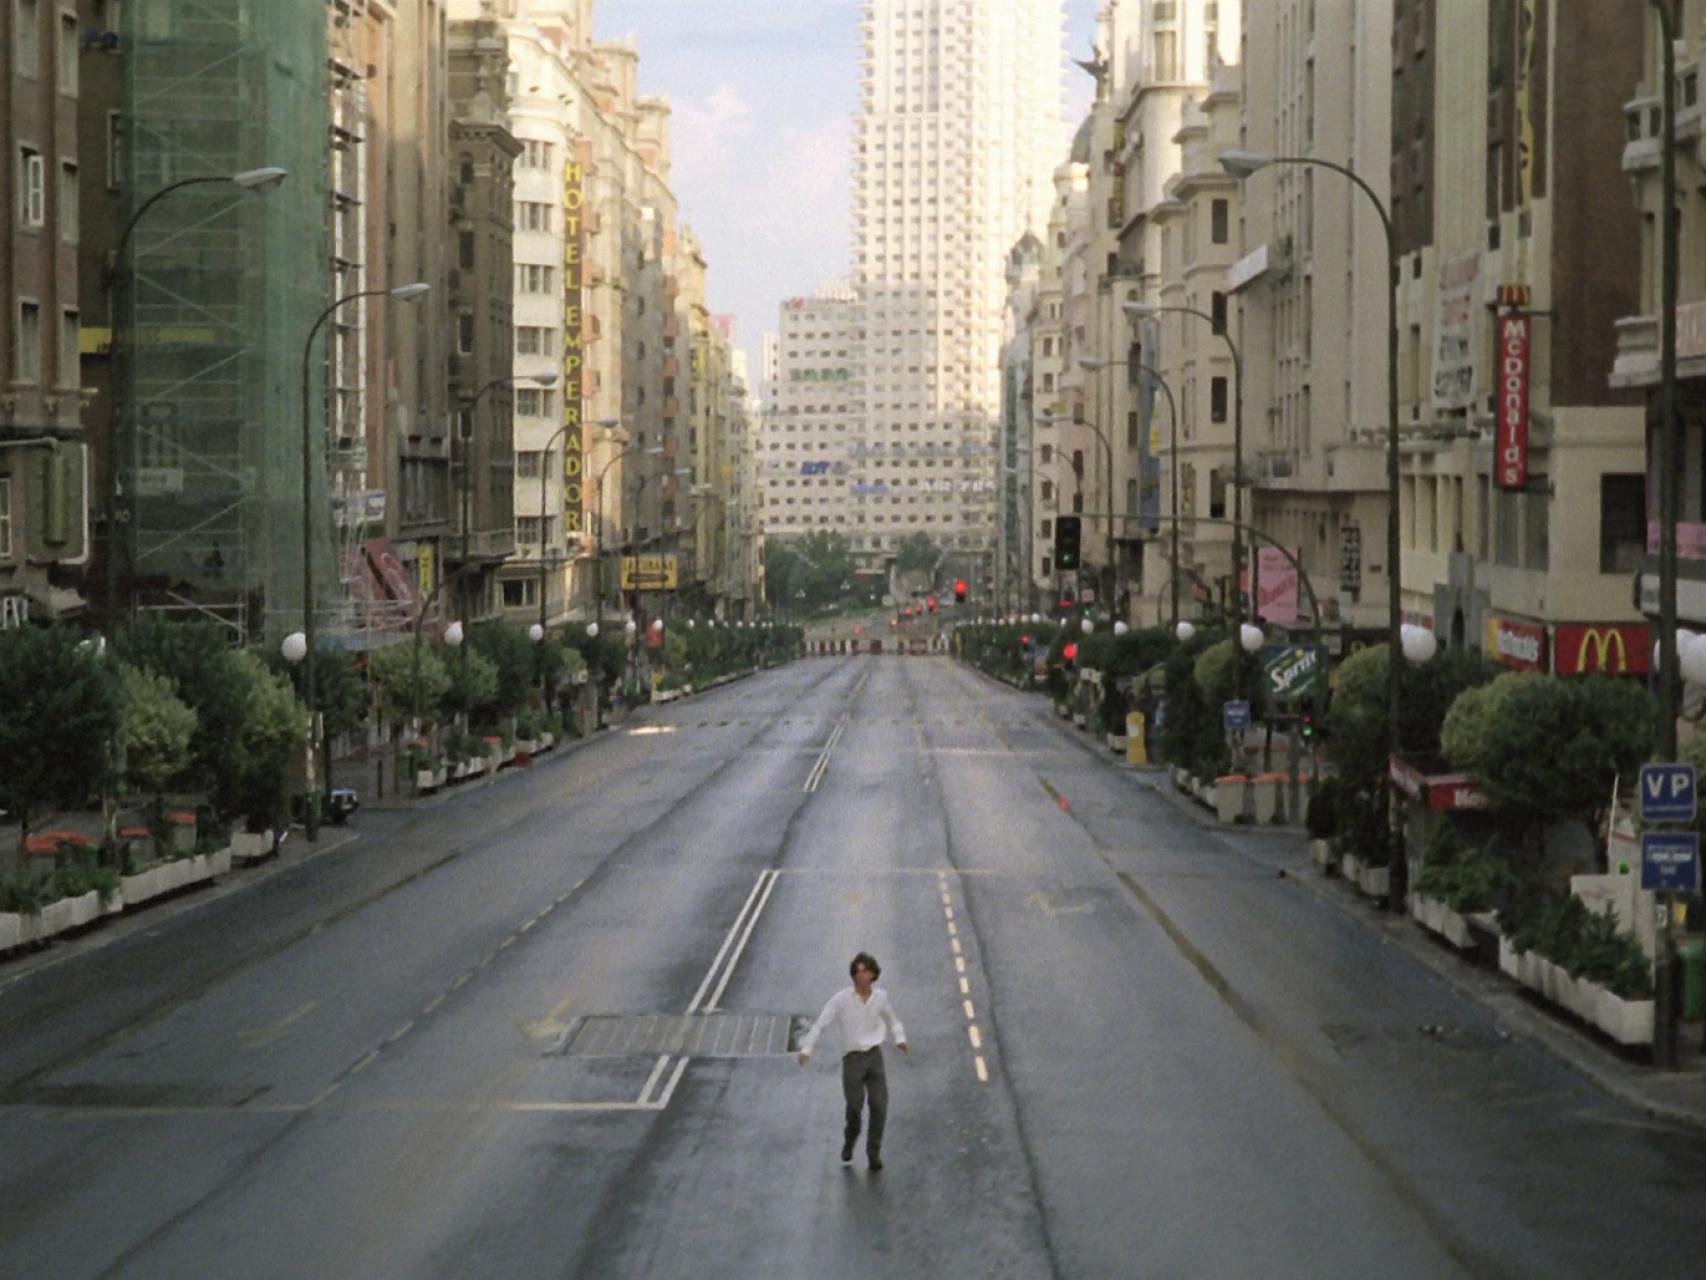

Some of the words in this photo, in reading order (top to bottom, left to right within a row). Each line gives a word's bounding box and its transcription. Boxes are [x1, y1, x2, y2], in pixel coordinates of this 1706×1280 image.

[564, 162, 583, 290] HOTEL
[564, 304, 582, 531] EMPERADOR
[1503, 318, 1526, 484] McDonald's
[1271, 648, 1317, 693] Sprit
